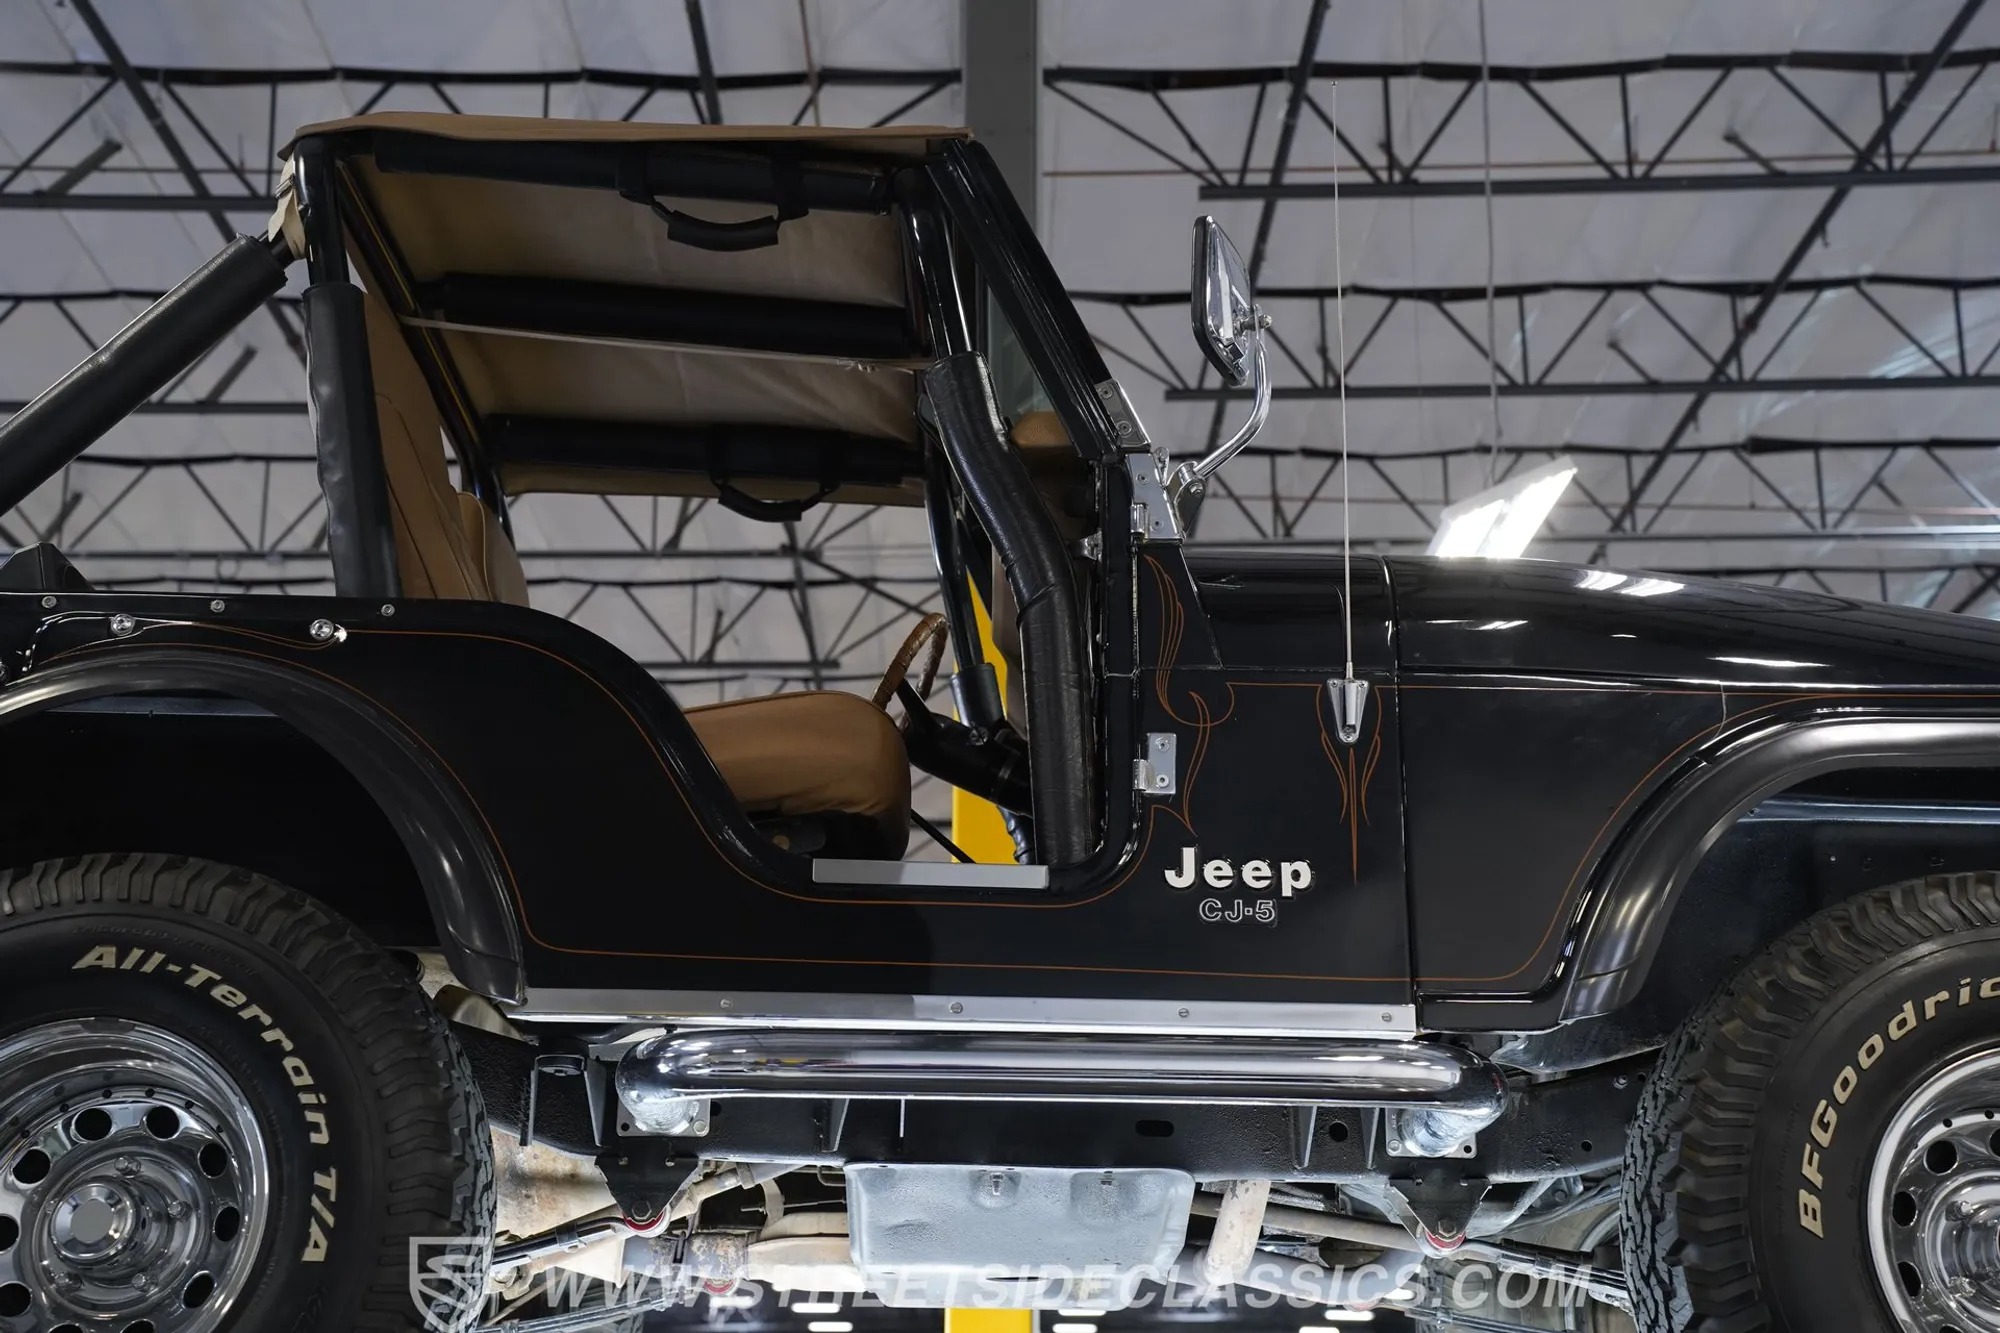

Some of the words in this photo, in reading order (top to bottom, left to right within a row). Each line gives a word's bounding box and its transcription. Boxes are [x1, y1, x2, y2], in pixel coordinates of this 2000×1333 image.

[1165, 846, 1313, 897] Jeep
[1199, 898, 1276, 922] CJ-5
[72, 945, 331, 1145] All-Terrain
[302, 1166, 337, 1262] T/A
